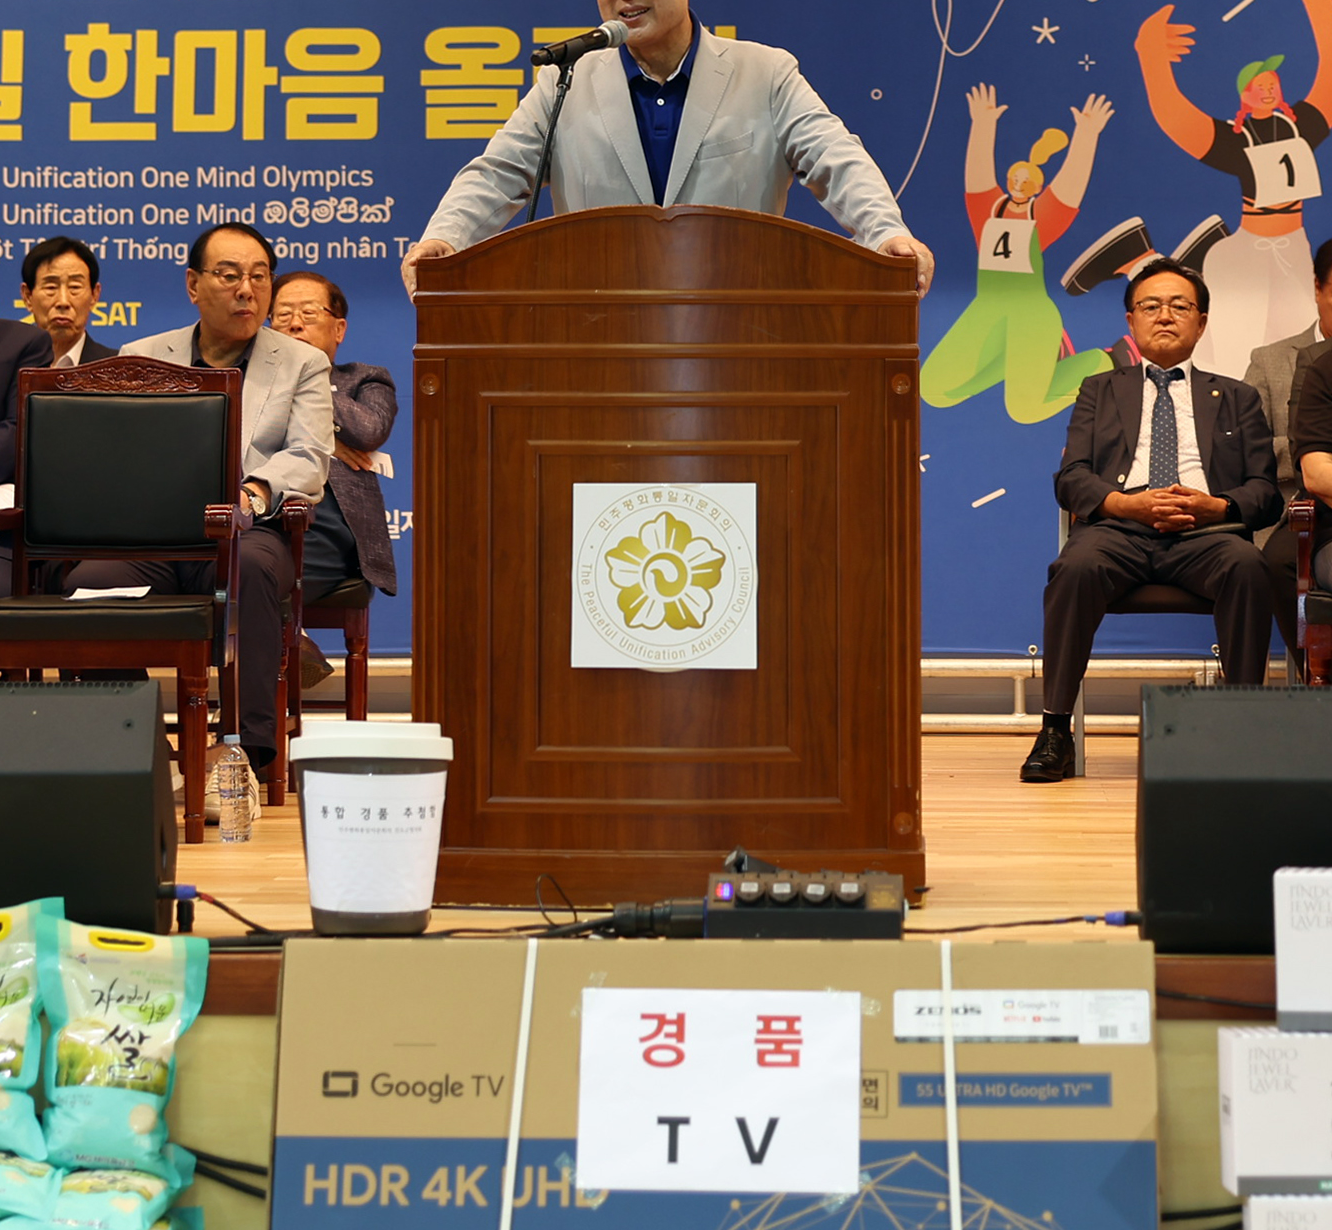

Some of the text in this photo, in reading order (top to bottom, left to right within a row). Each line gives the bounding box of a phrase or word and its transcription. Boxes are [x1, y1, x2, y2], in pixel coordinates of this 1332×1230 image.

[63, 21, 386, 141] 한마음
[1, 165, 135, 189] Unification
[140, 166, 191, 189] One
[196, 166, 256, 189] Mind
[262, 164, 375, 192] Olympics
[1278, 152, 1294, 188] 1
[1, 202, 135, 226] Unification
[140, 203, 191, 226] One
[196, 202, 256, 225] Mind
[266, 236, 320, 265] ông
[326, 236, 388, 259] nhân
[991, 230, 1013, 260] 4
[90, 301, 143, 327] SAT
[598, 490, 733, 533] 민주평화통일자문회의
[580, 563, 751, 661] The Peaceful Unification Advisory Council
[359, 807, 389, 822] 경품
[370, 1072, 506, 1104] Google TV
[916, 1082, 935, 1098] 55
[937, 1082, 984, 1098] UTRA
[985, 1082, 1007, 1098] HD
[1009, 1082, 1060, 1101] Google
[302, 1162, 410, 1207] HDR
[420, 1164, 489, 1208] 4K
